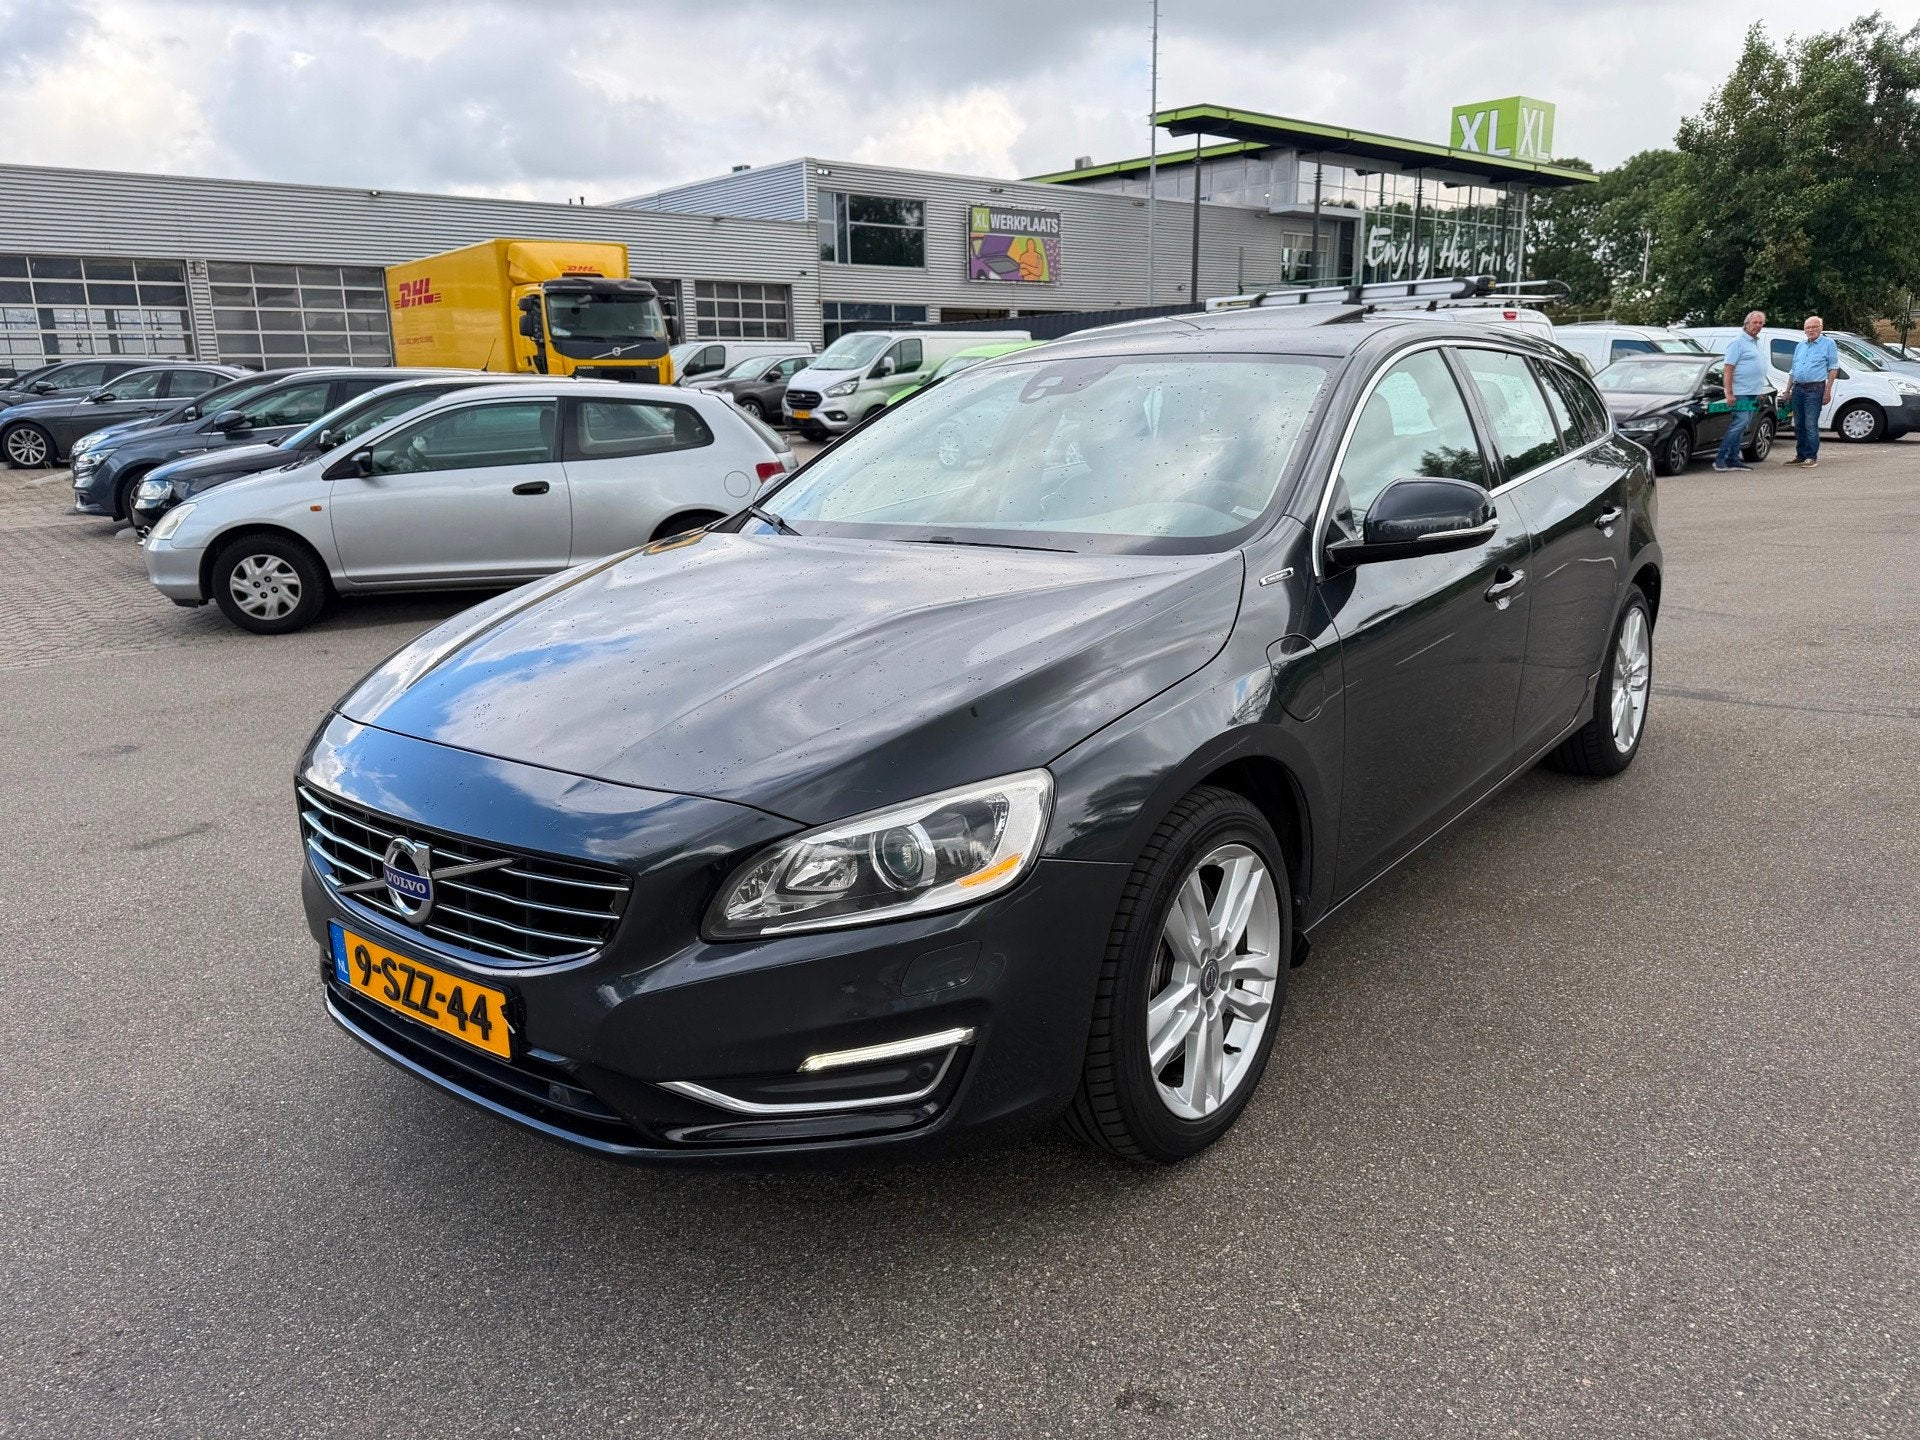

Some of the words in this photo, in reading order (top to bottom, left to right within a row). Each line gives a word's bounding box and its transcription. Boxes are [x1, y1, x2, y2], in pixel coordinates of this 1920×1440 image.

[1457, 109, 1511, 156] XL
[1518, 107, 1551, 161] XL
[974, 212, 990, 228] XL
[990, 213, 1059, 233] WERKPLAATS
[1438, 223, 1471, 270] the
[399, 277, 435, 309] DHL
[385, 869, 428, 894] VOLVO
[337, 958, 349, 975] NL
[354, 943, 493, 1041] 9-SZZ-44
